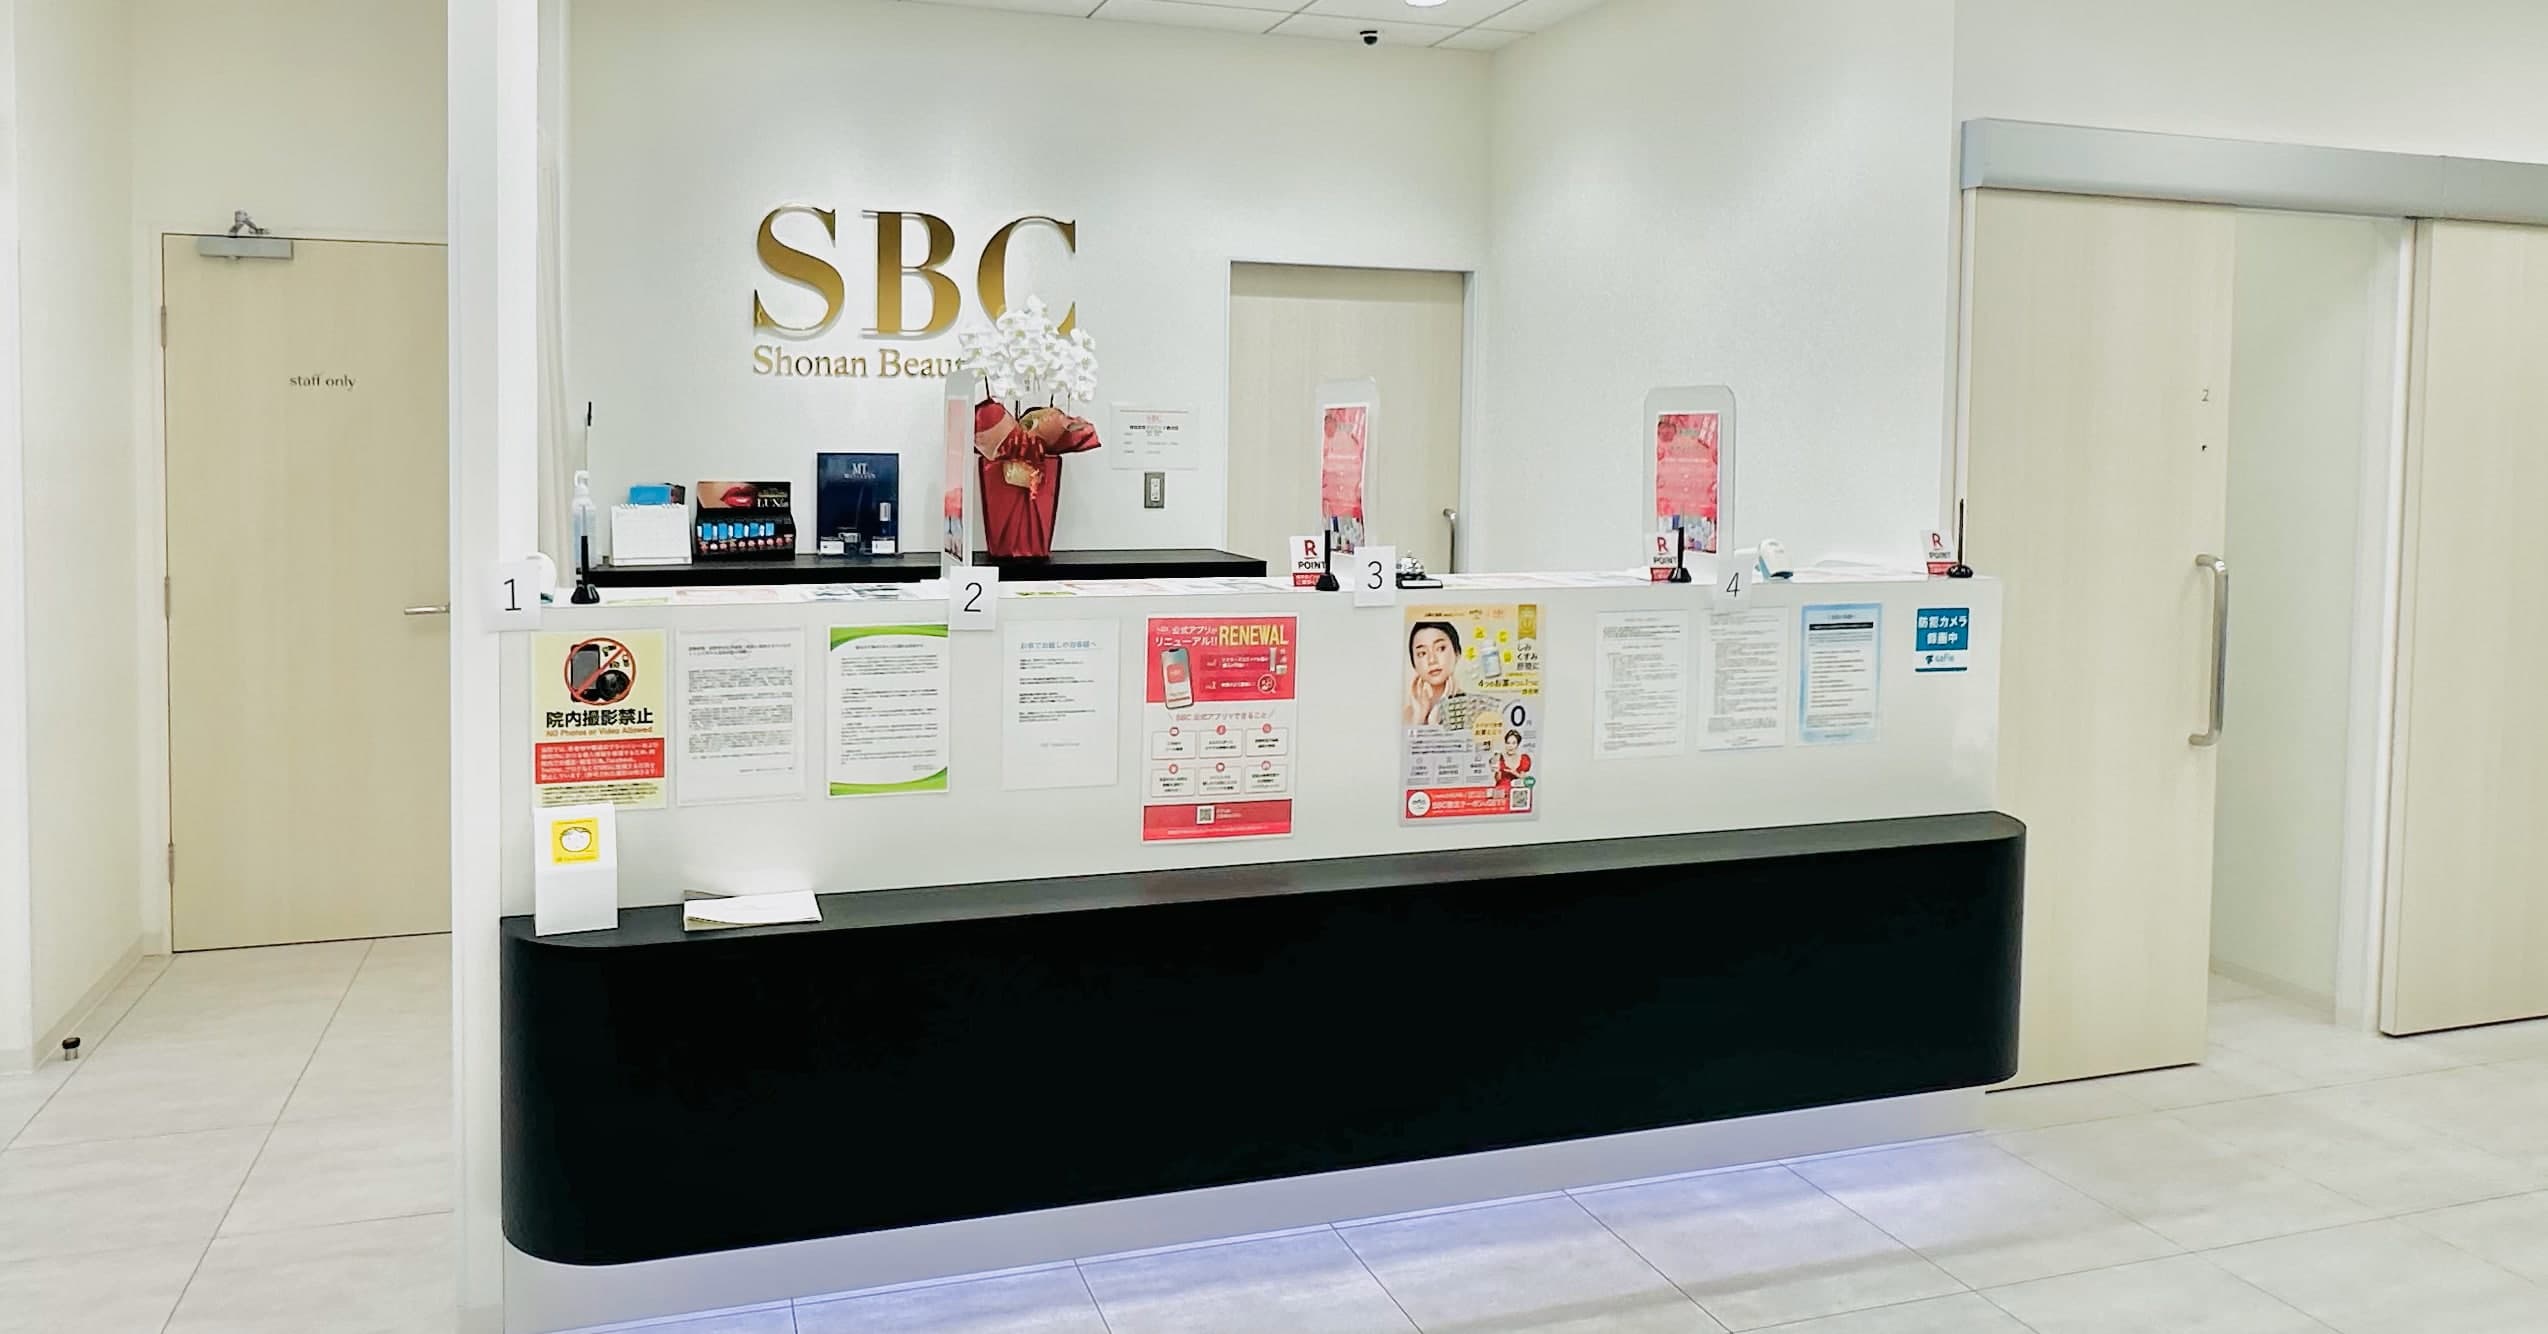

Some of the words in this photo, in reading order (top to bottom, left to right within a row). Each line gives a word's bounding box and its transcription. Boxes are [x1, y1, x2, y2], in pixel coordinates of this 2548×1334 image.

[753, 204, 1077, 337] SBC
[752, 344, 868, 378] Shonan
[878, 348, 966, 378] Beaut
[289, 373, 321, 388] staff
[325, 374, 356, 391] only
[1304, 539, 1318, 556] R
[1656, 536, 1669, 552] R
[1931, 532, 1944, 548] R
[1298, 560, 1327, 570] POINT
[1366, 560, 1384, 590] 3
[503, 578, 522, 612] 1
[1726, 571, 1740, 598] 4
[963, 582, 983, 613] 2
[1219, 624, 1289, 647] RENEWAL
[546, 708, 654, 728] 院内撮影禁止
[1511, 705, 1526, 727] 0
